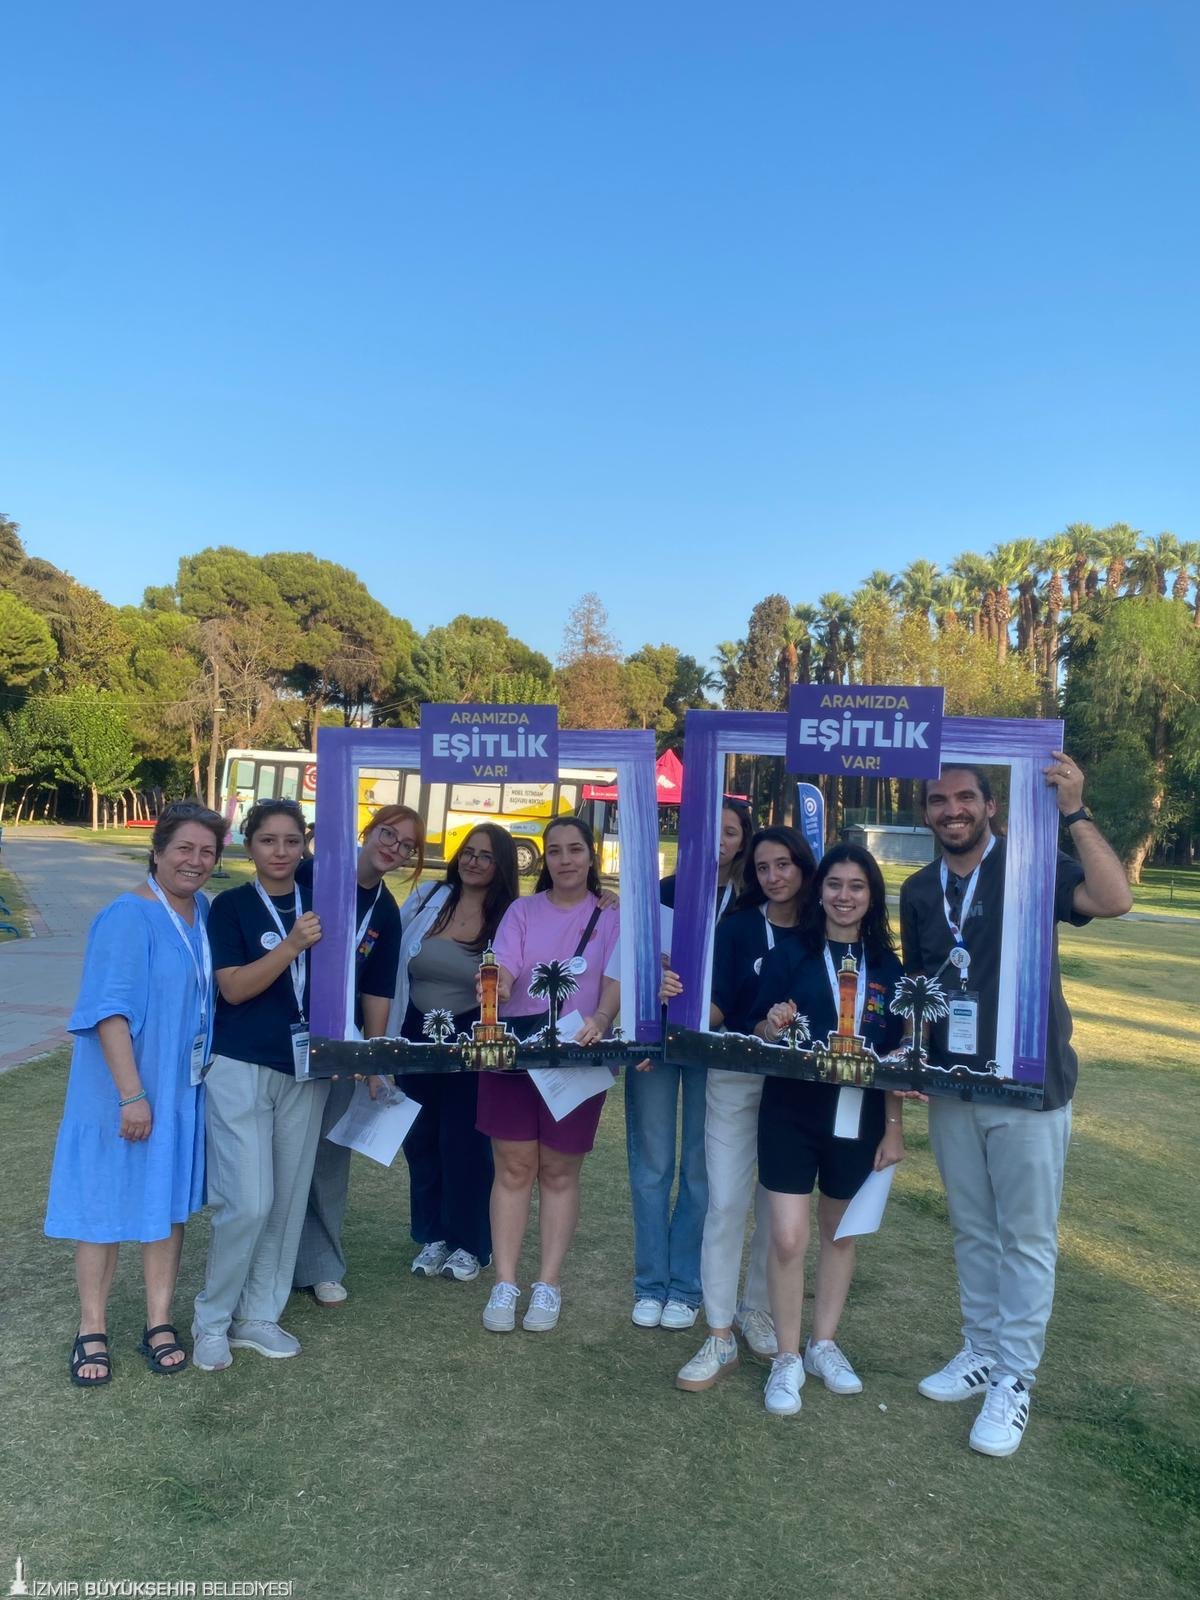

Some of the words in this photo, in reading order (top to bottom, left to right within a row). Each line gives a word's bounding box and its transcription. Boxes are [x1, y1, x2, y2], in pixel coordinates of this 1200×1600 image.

[820, 694, 909, 710] ARAMIZDA
[450, 712, 530, 725] ARAMIZDA
[799, 711, 930, 752] EŞİTLİK
[432, 726, 549, 763] EŞİTLİK
[841, 755, 880, 770] VAR!
[472, 765, 508, 777] VAR!
